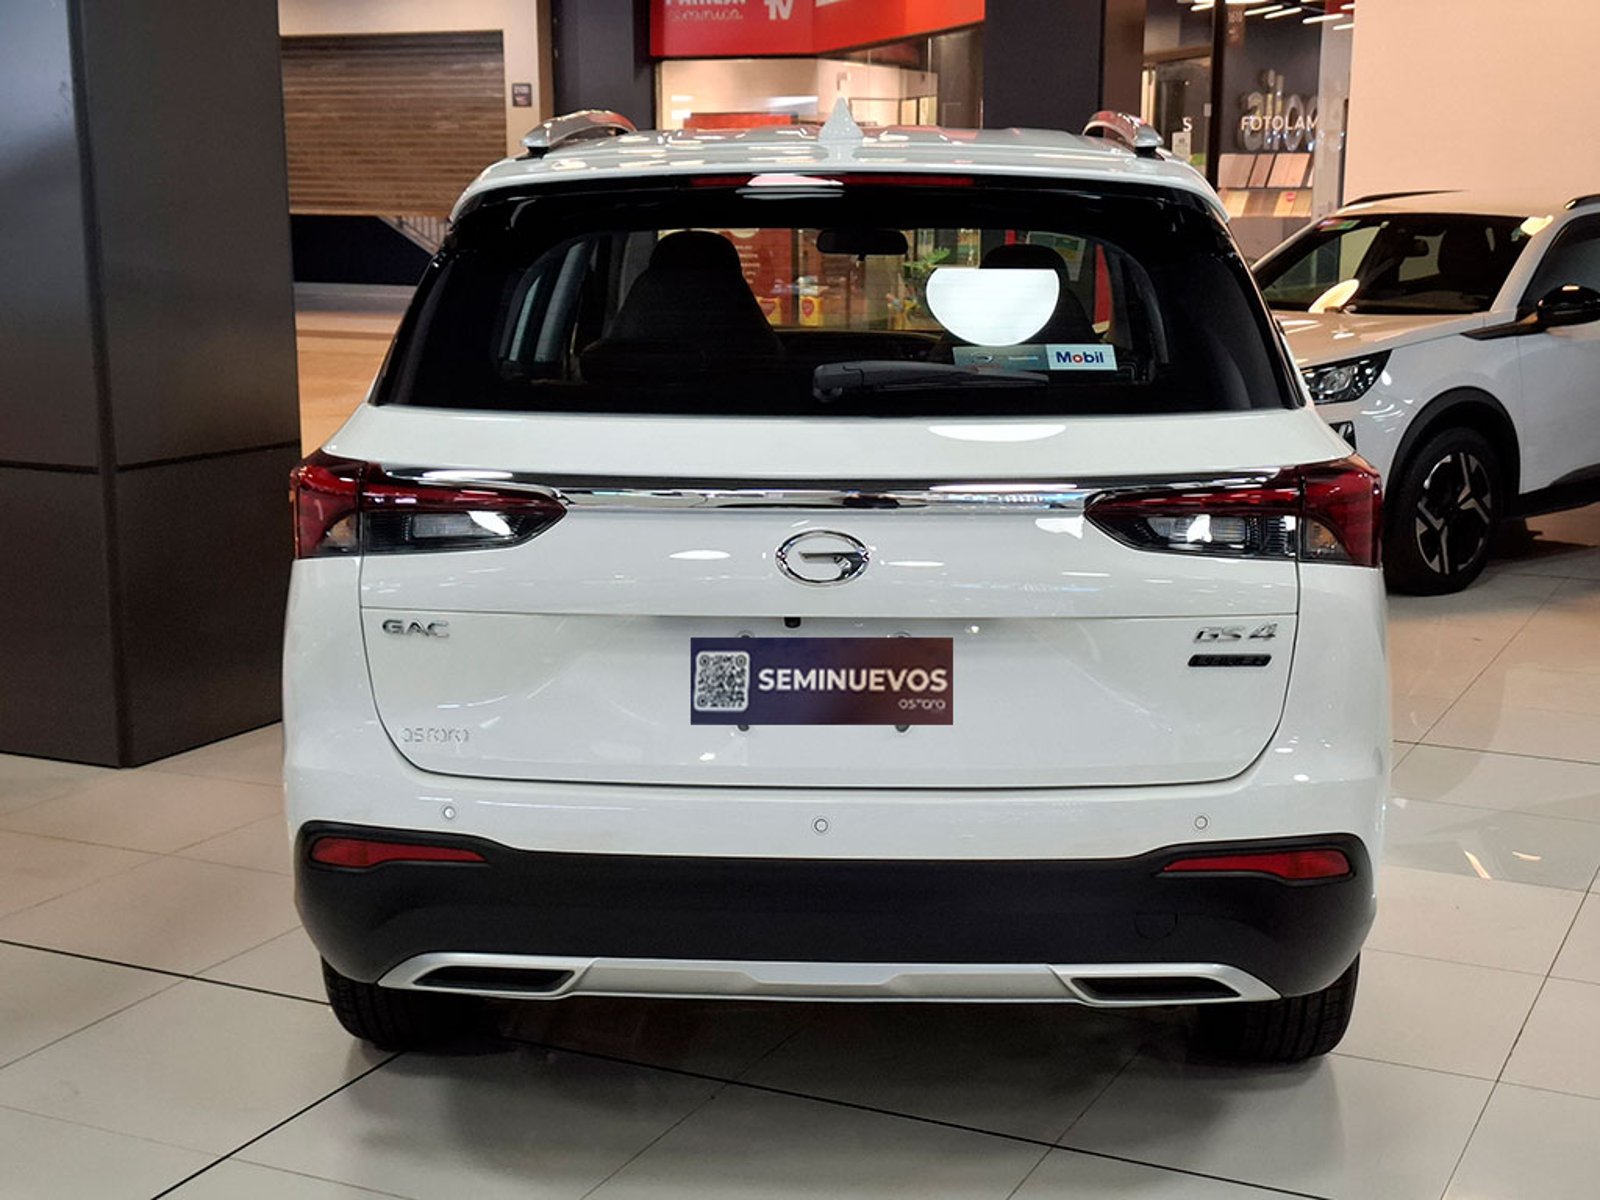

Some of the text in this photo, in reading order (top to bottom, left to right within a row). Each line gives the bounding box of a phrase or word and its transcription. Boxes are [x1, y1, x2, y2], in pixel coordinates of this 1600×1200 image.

[1055, 351, 1104, 364] Mobil
[382, 619, 450, 638] GAC
[758, 668, 948, 692] SEMINUEVOS
